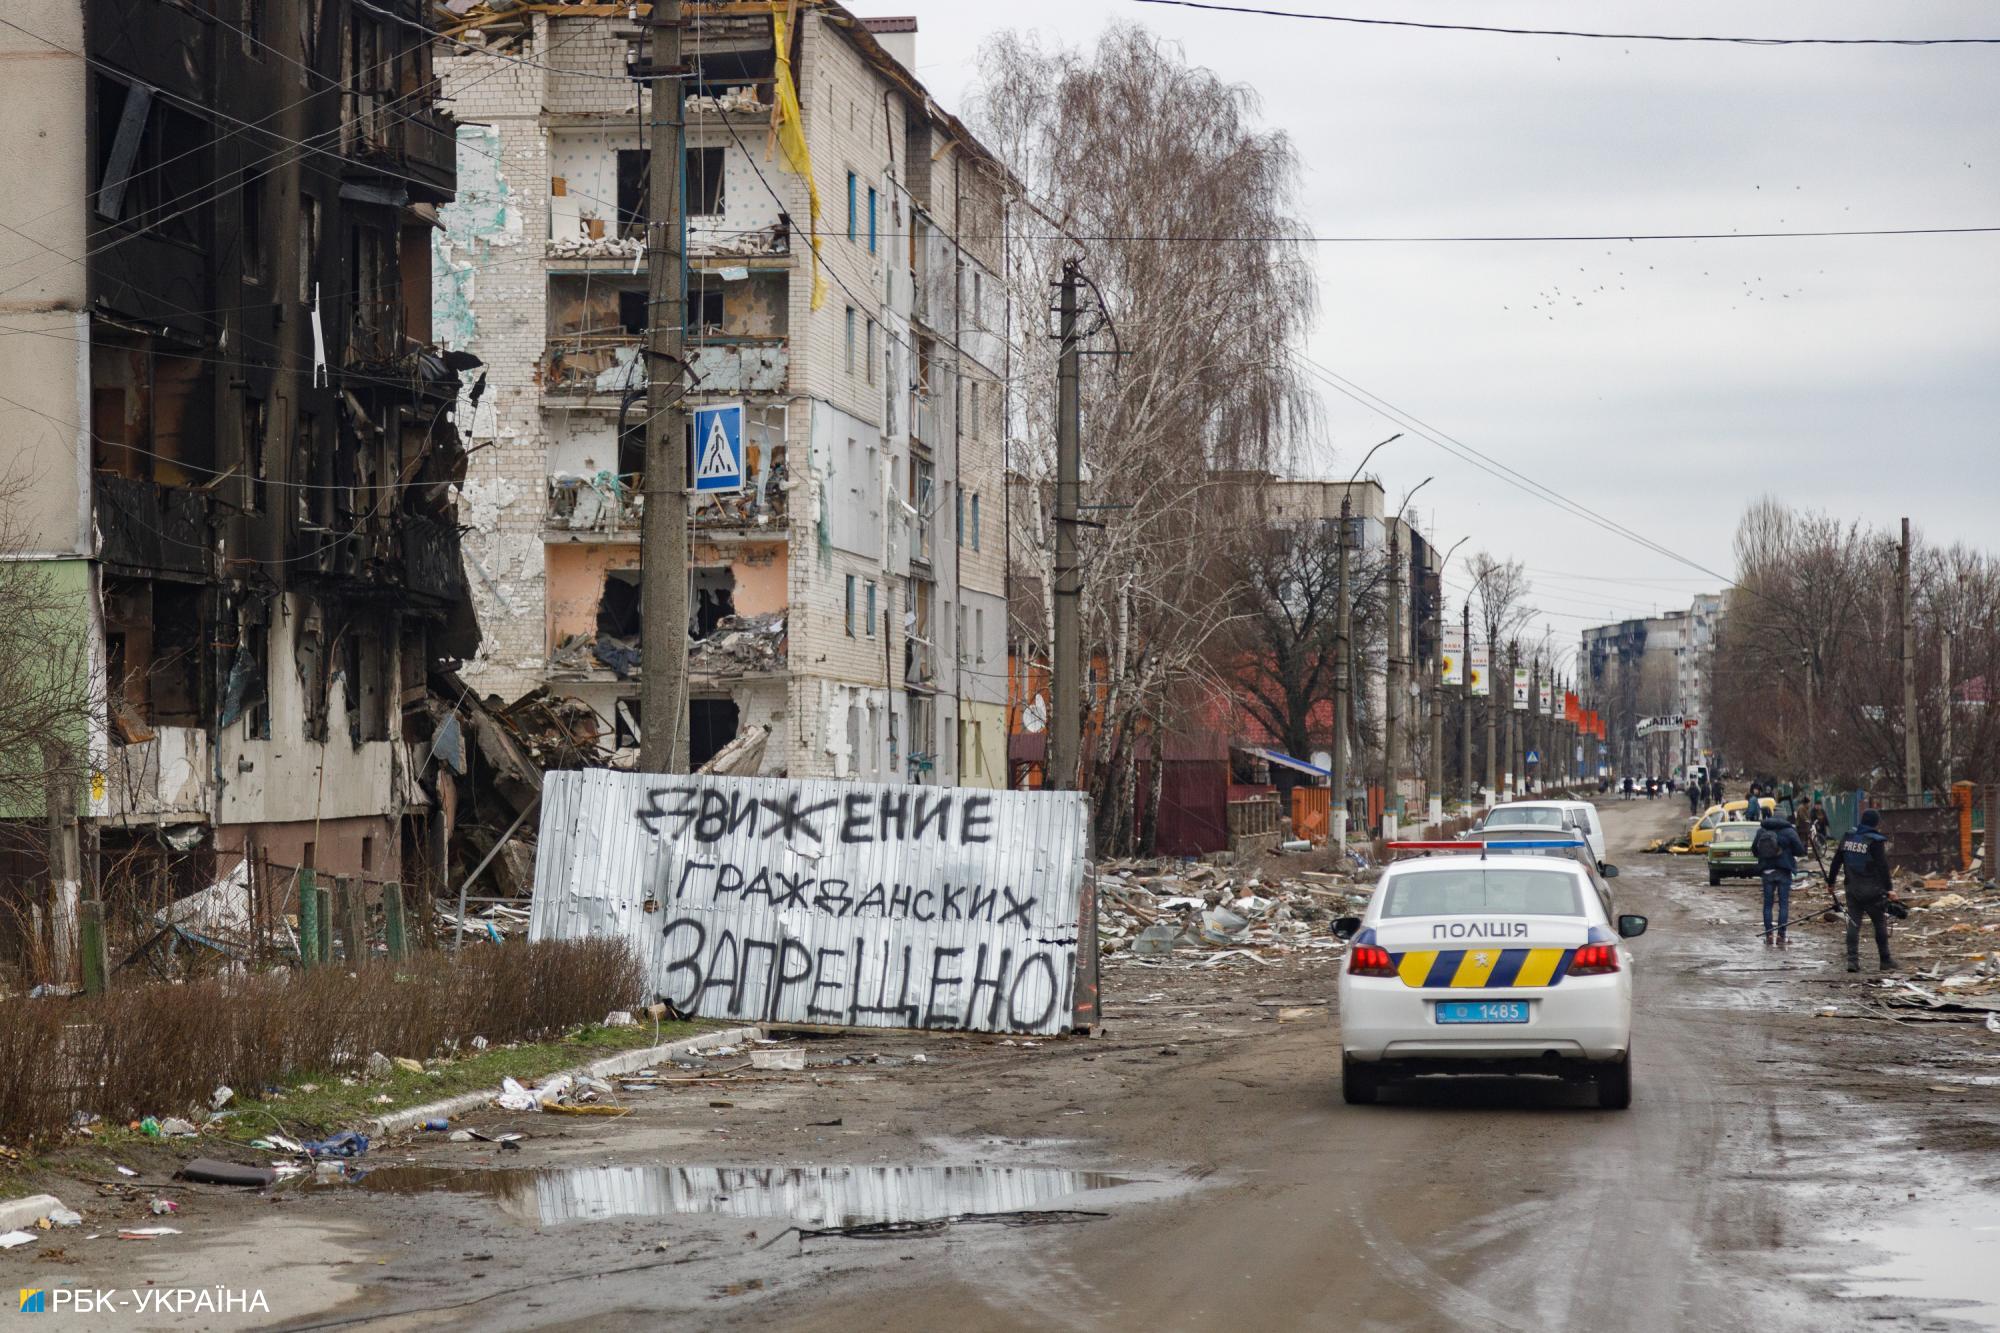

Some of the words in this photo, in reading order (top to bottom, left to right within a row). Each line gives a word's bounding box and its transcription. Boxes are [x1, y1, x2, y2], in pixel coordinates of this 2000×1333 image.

[634, 787, 992, 846] ДВИЖЕНИЕ
[1844, 841, 1868, 854] PRESS
[676, 860, 1038, 930] ГРАЖДАНСКИХ
[1433, 923, 1528, 939] ПОЛІЦІЯ
[662, 918, 1076, 1033] ЗАПРЕЩЕНО!
[1480, 1004, 1519, 1018] 1485
